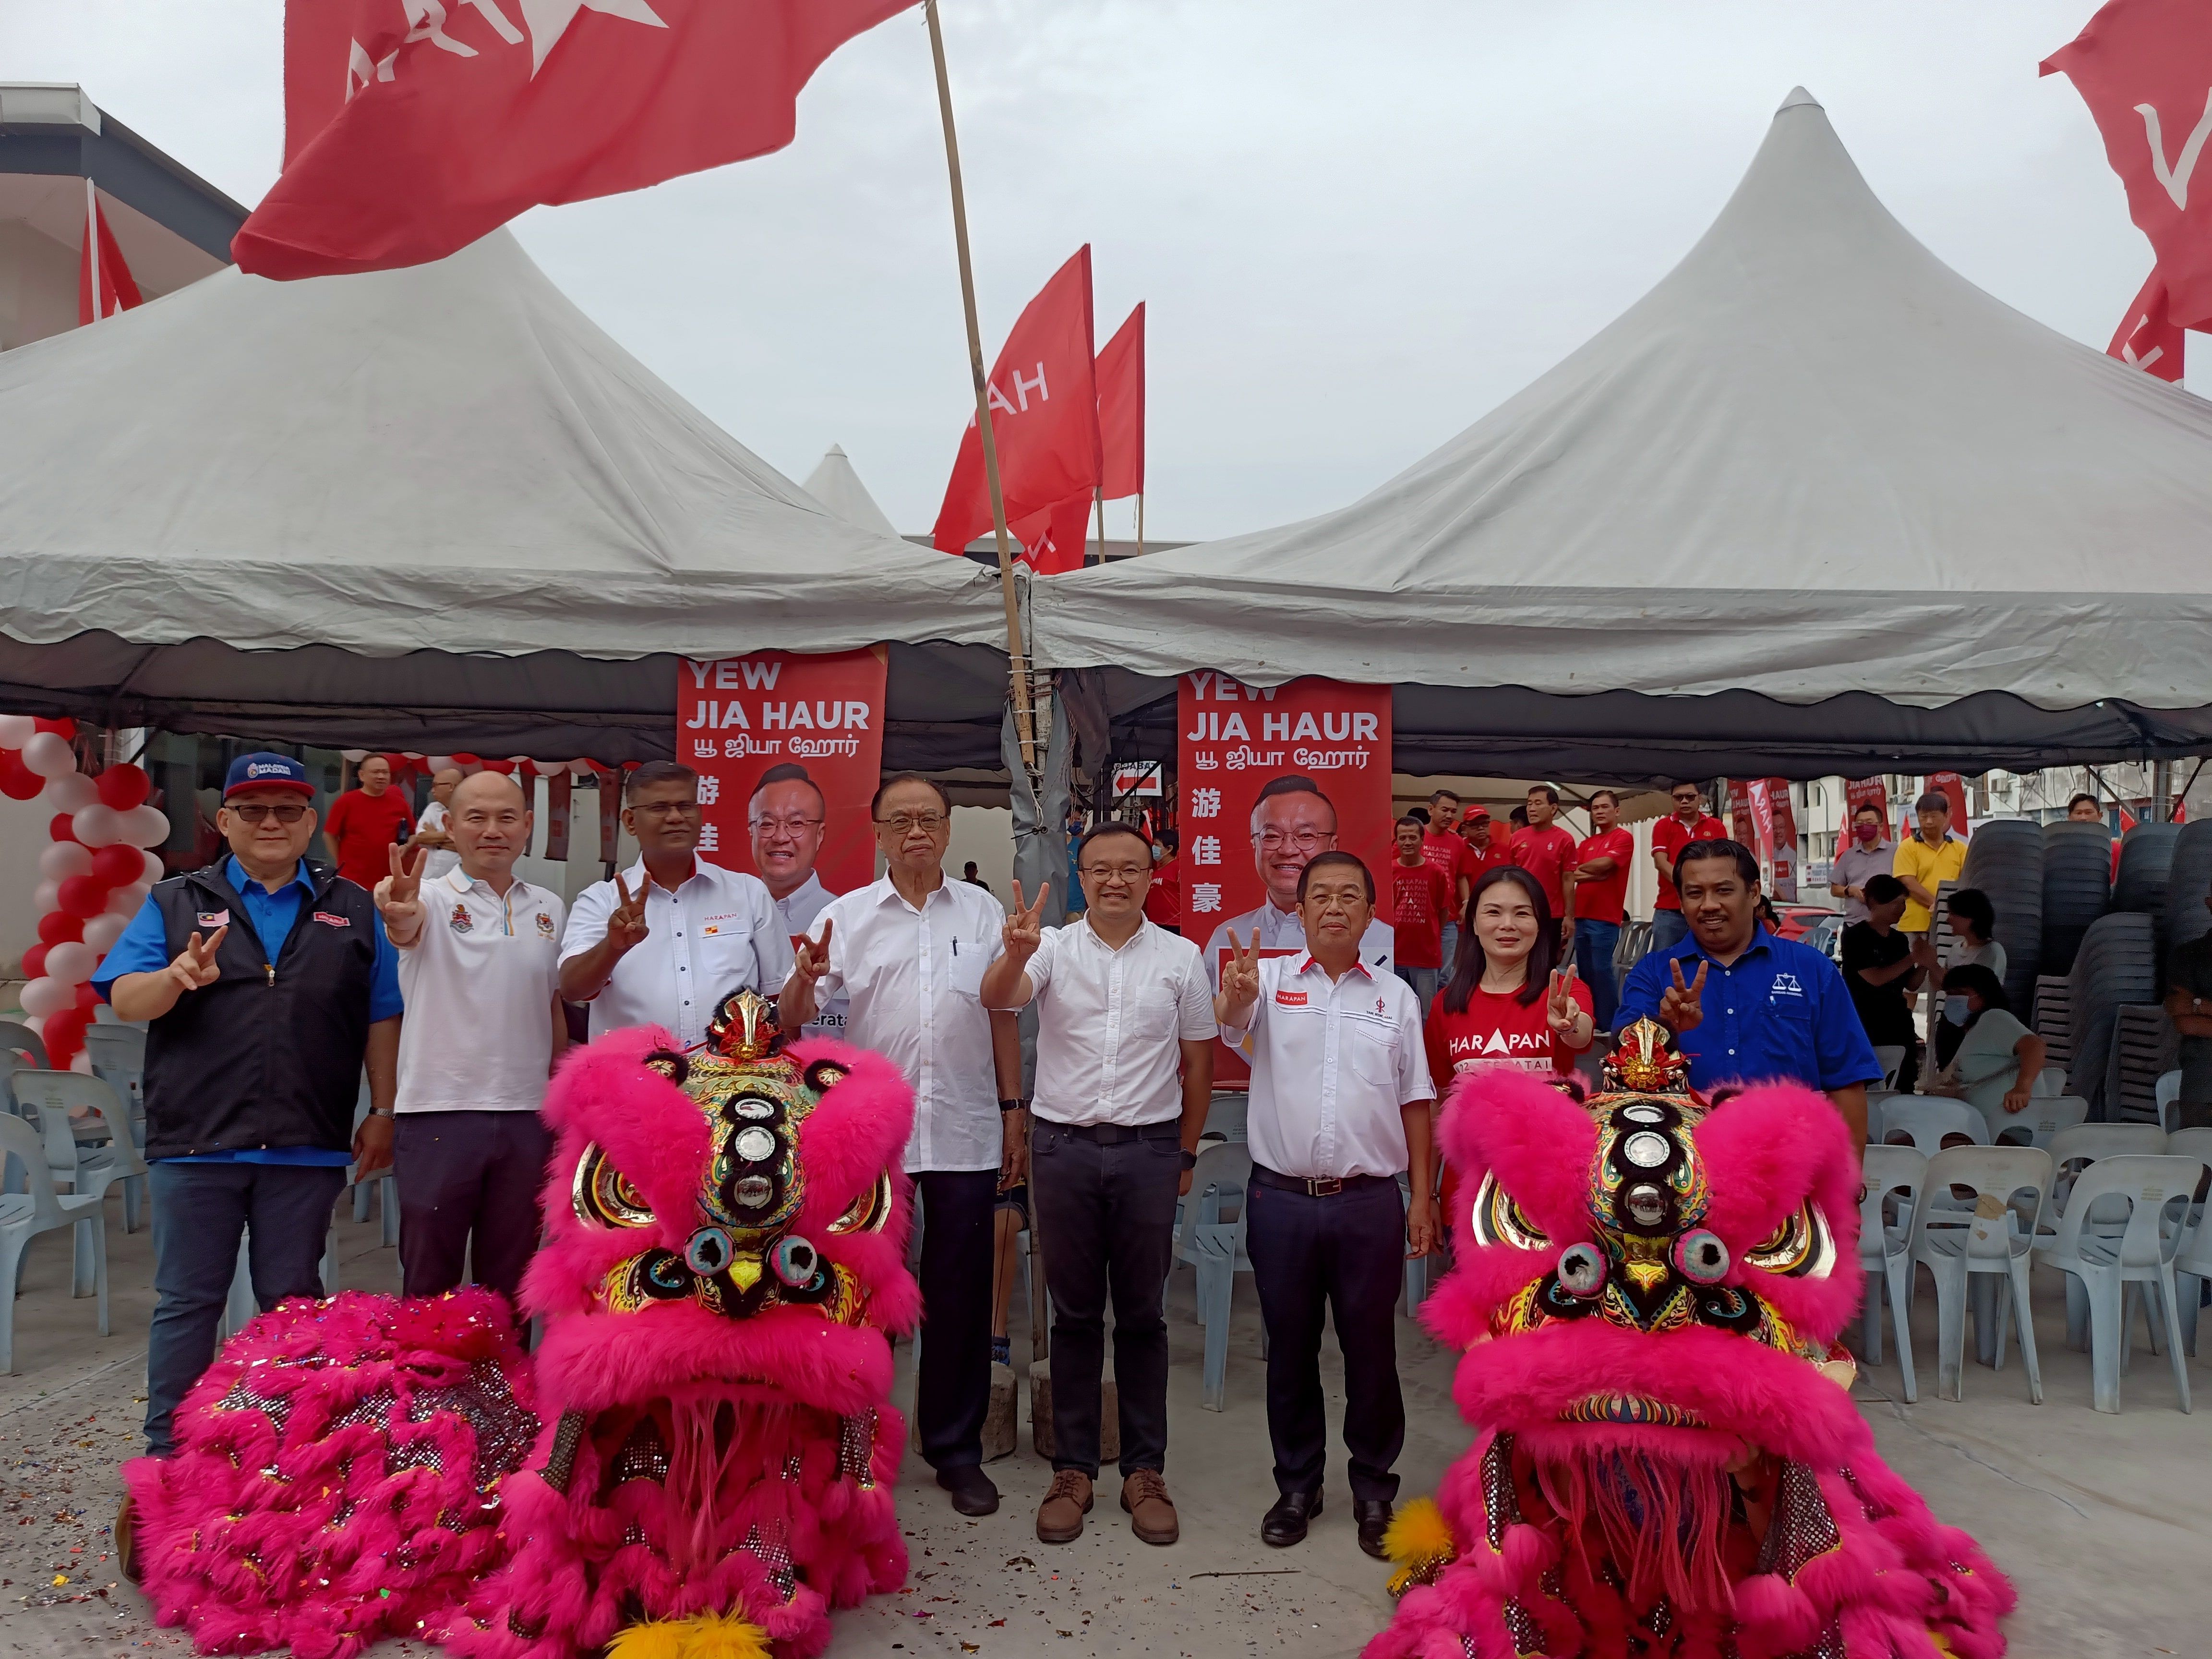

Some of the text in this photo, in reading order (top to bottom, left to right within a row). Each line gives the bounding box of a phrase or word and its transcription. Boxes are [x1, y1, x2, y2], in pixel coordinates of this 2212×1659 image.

[686, 661, 781, 690] YEW
[685, 701, 869, 730] JIA HAUR
[1187, 712, 1378, 741] JIA HAUR
[694, 733, 859, 758] யூ ஜியா ஹோர்
[1195, 745, 1370, 770] யூ ஜியா ஹோர்
[1191, 788, 1222, 913] 游佳豪
[704, 913, 737, 921] HARAPAN
[1277, 994, 1306, 1002] HARAPAN
[1450, 1027, 1550, 1056] HARAPAN
